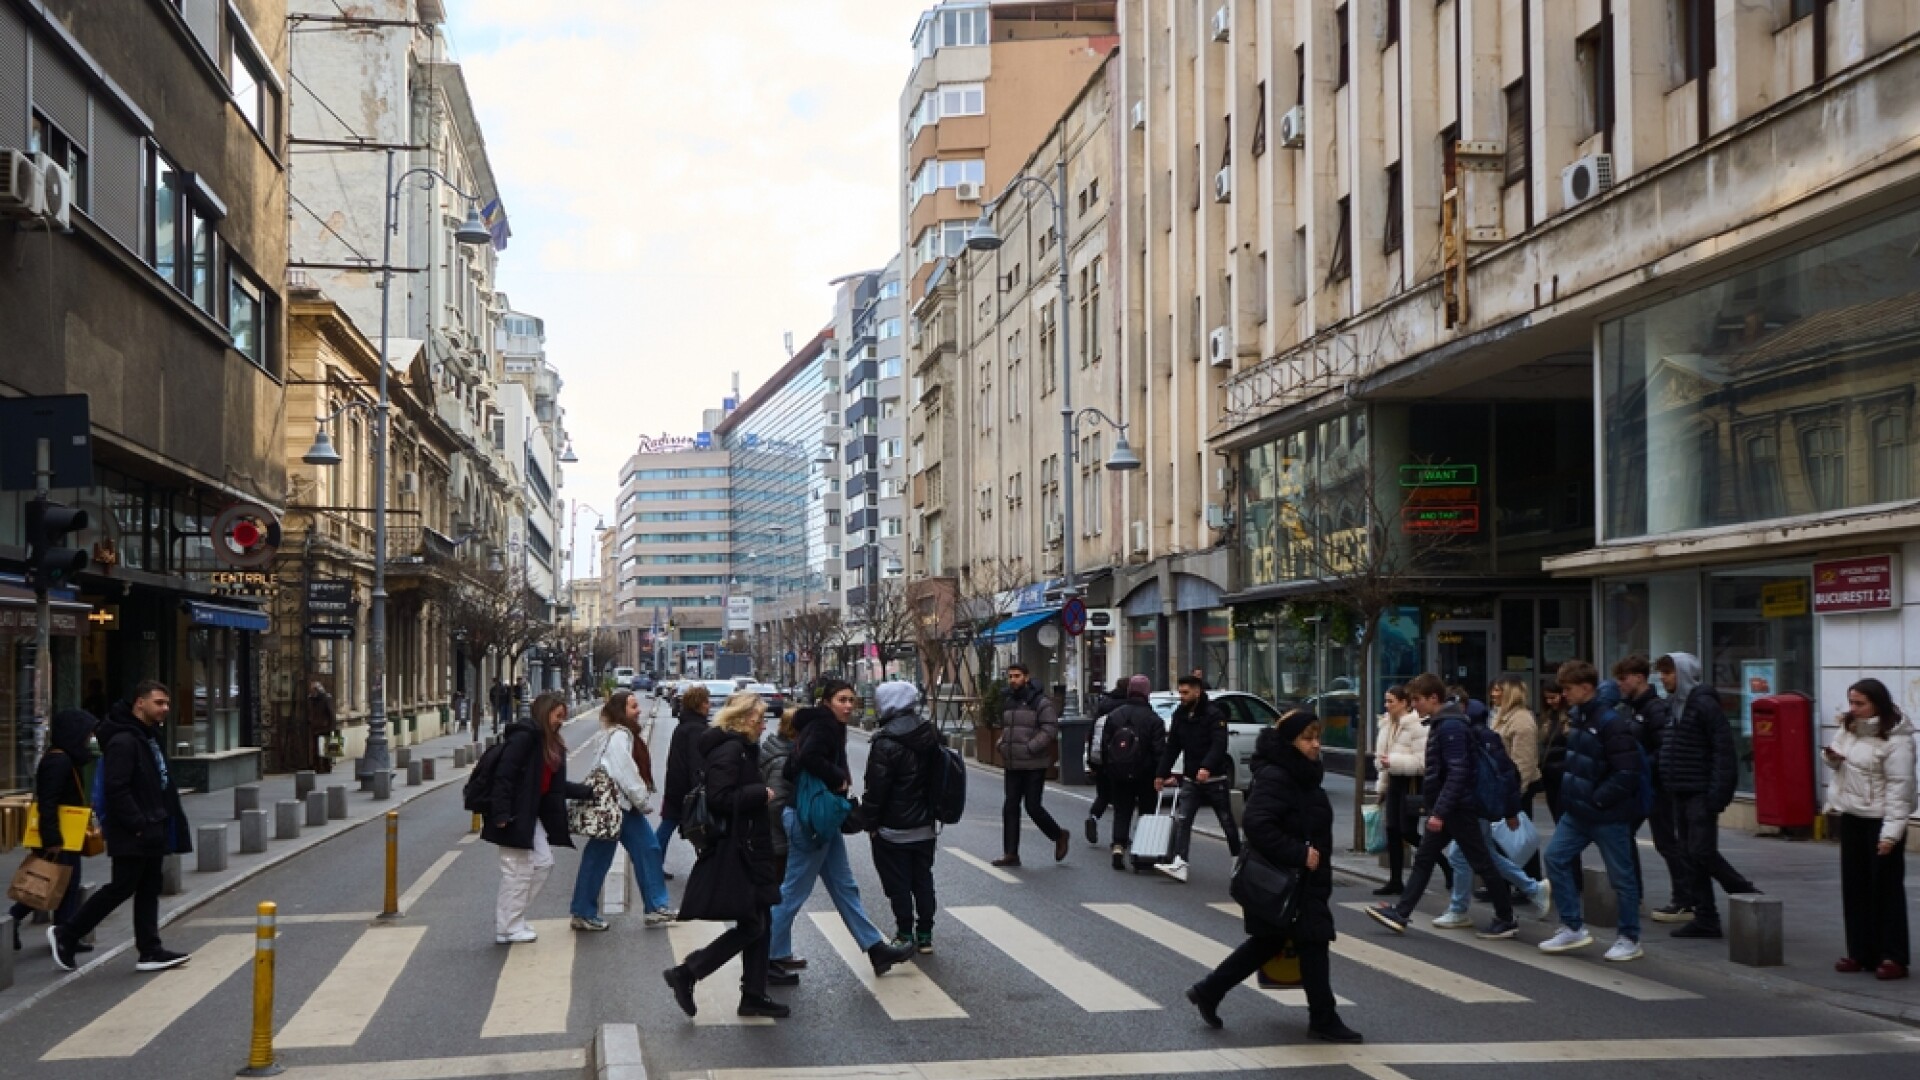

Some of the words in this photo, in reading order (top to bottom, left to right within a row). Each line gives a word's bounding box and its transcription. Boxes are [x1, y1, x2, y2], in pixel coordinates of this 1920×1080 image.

[1424, 470, 1458, 480] WANT
[210, 572, 279, 585] CENTRALE
[1877, 588, 1890, 600] 22
